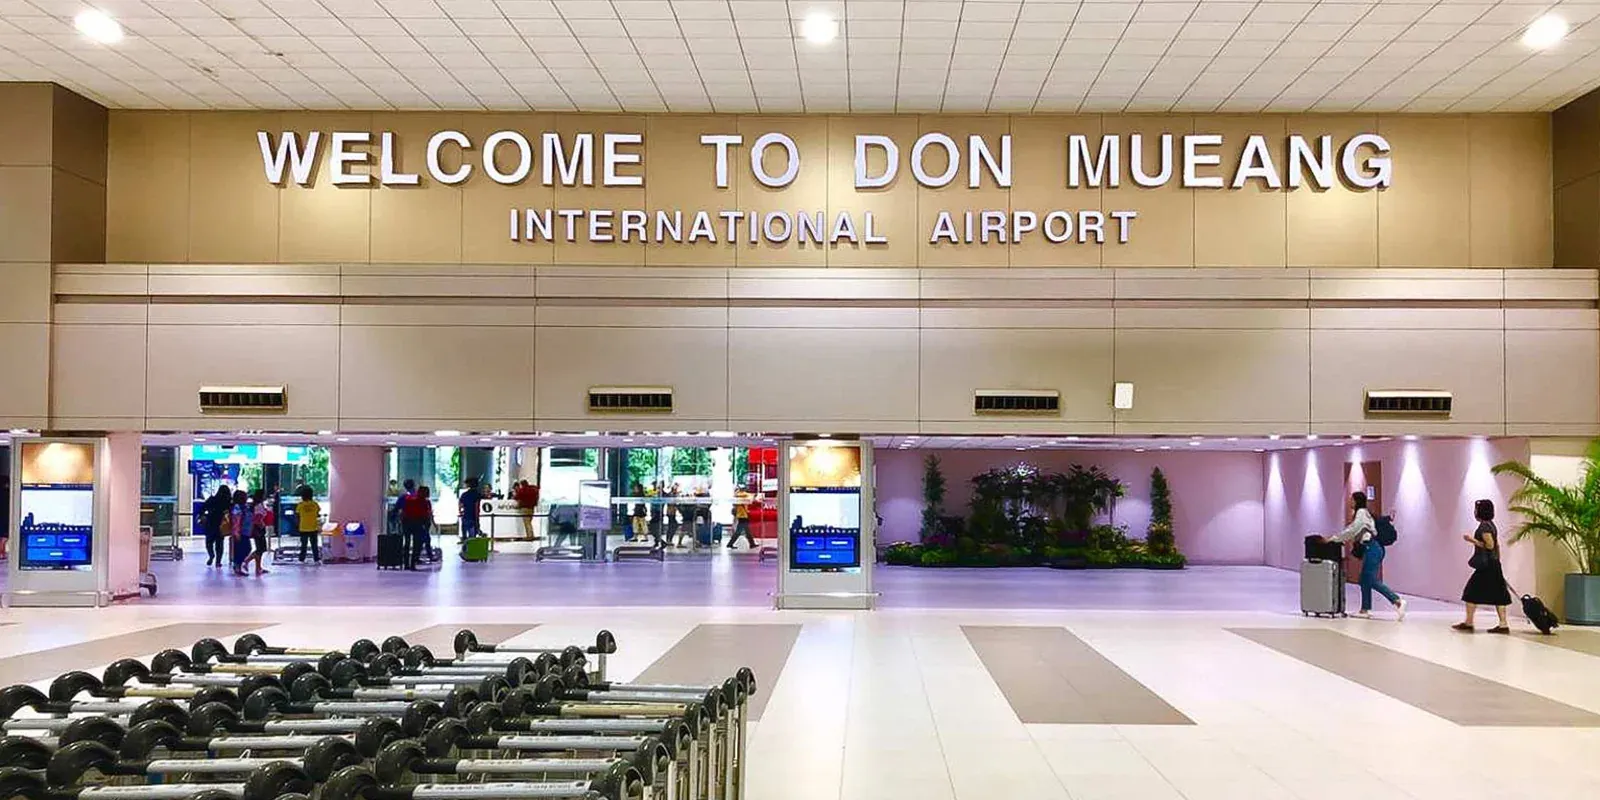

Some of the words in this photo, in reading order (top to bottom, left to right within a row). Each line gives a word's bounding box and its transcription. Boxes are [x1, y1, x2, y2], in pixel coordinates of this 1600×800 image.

[256, 130, 645, 187] WELCOME
[700, 132, 800, 188] TO
[853, 132, 1013, 189] DON
[1067, 133, 1393, 190] MUEANG
[509, 208, 888, 244] INTERNATIONAL
[930, 209, 1137, 244] AIRPORT
